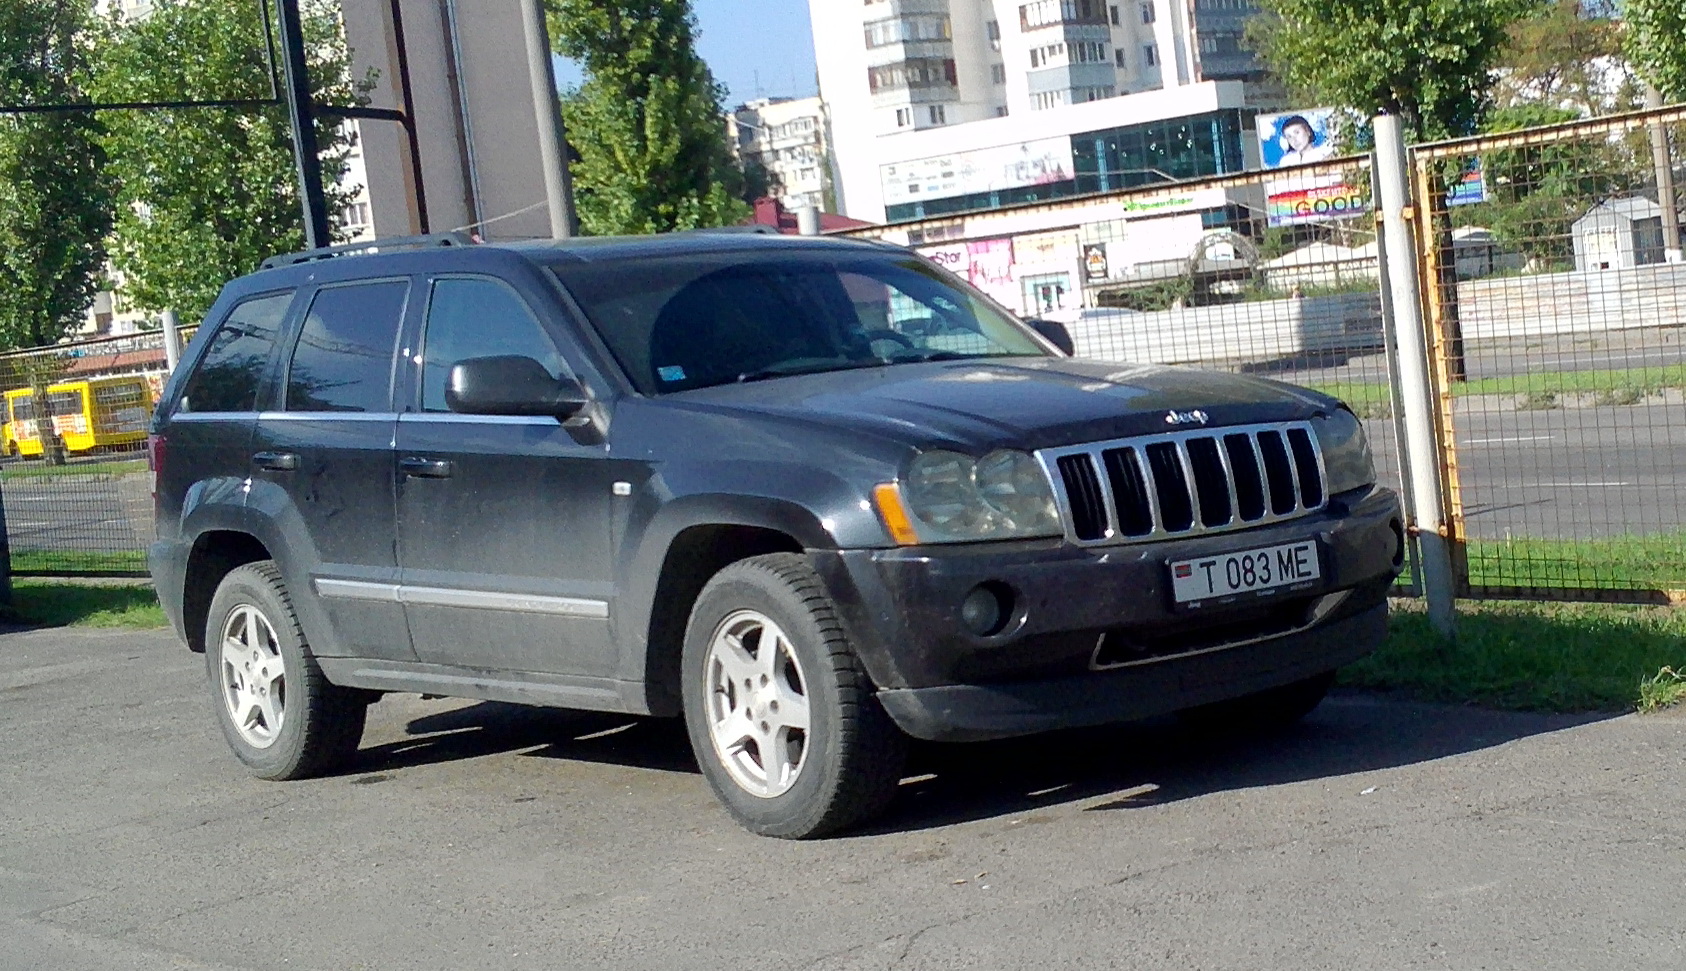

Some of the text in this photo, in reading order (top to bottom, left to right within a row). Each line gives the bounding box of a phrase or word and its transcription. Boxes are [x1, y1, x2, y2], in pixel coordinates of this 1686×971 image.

[1165, 409, 1209, 425] Jeep
[1199, 545, 1312, 593] T 083 ME
